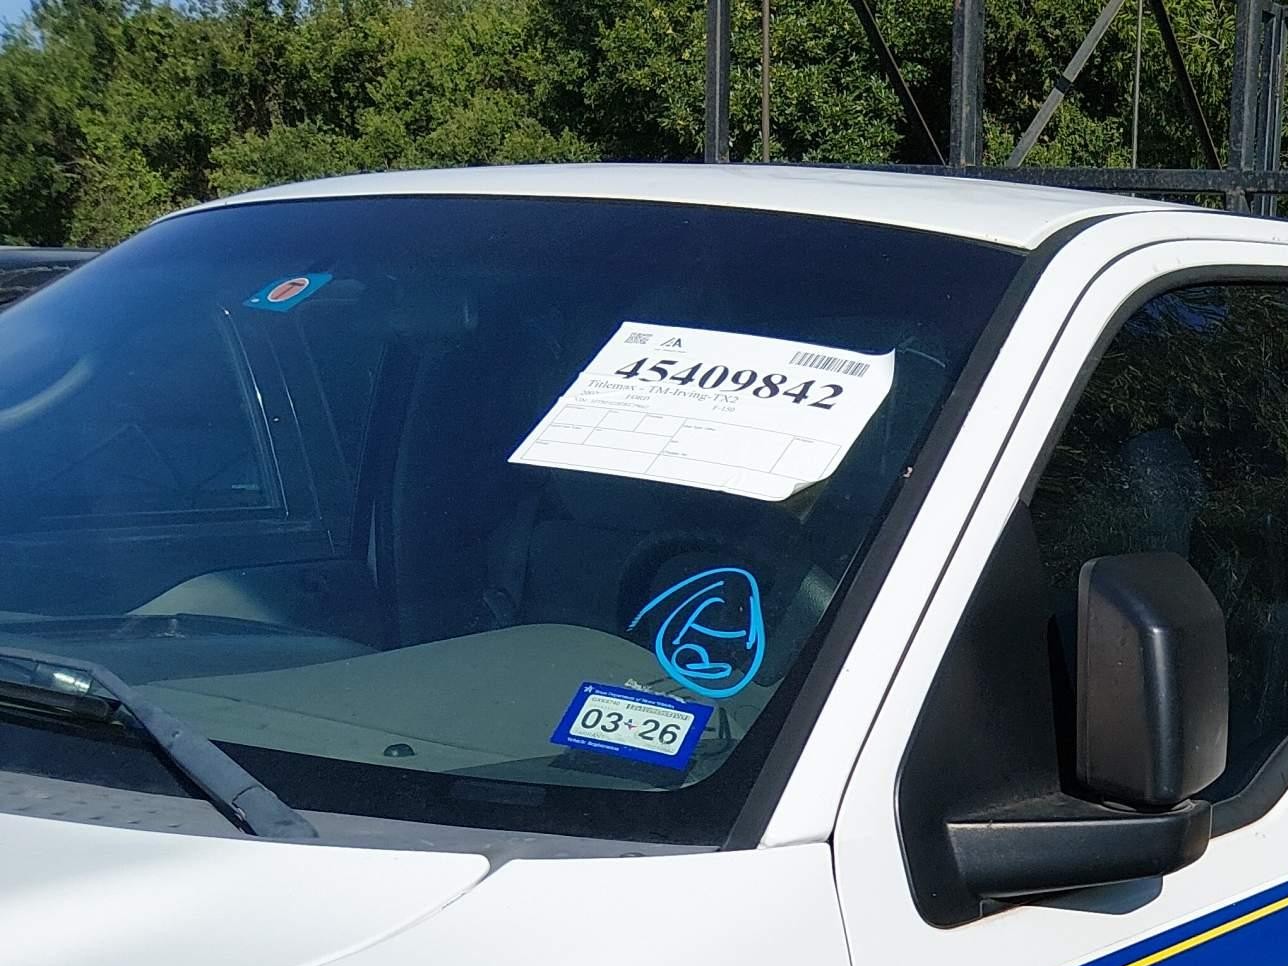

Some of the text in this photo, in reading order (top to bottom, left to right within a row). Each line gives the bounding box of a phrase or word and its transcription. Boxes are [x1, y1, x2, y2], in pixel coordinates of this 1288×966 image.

[588, 379, 638, 392] Titlemax
[648, 384, 740, 404] TM-Irving-TX2
[614, 357, 844, 411] 45409842
[580, 708, 682, 745] 03 26
